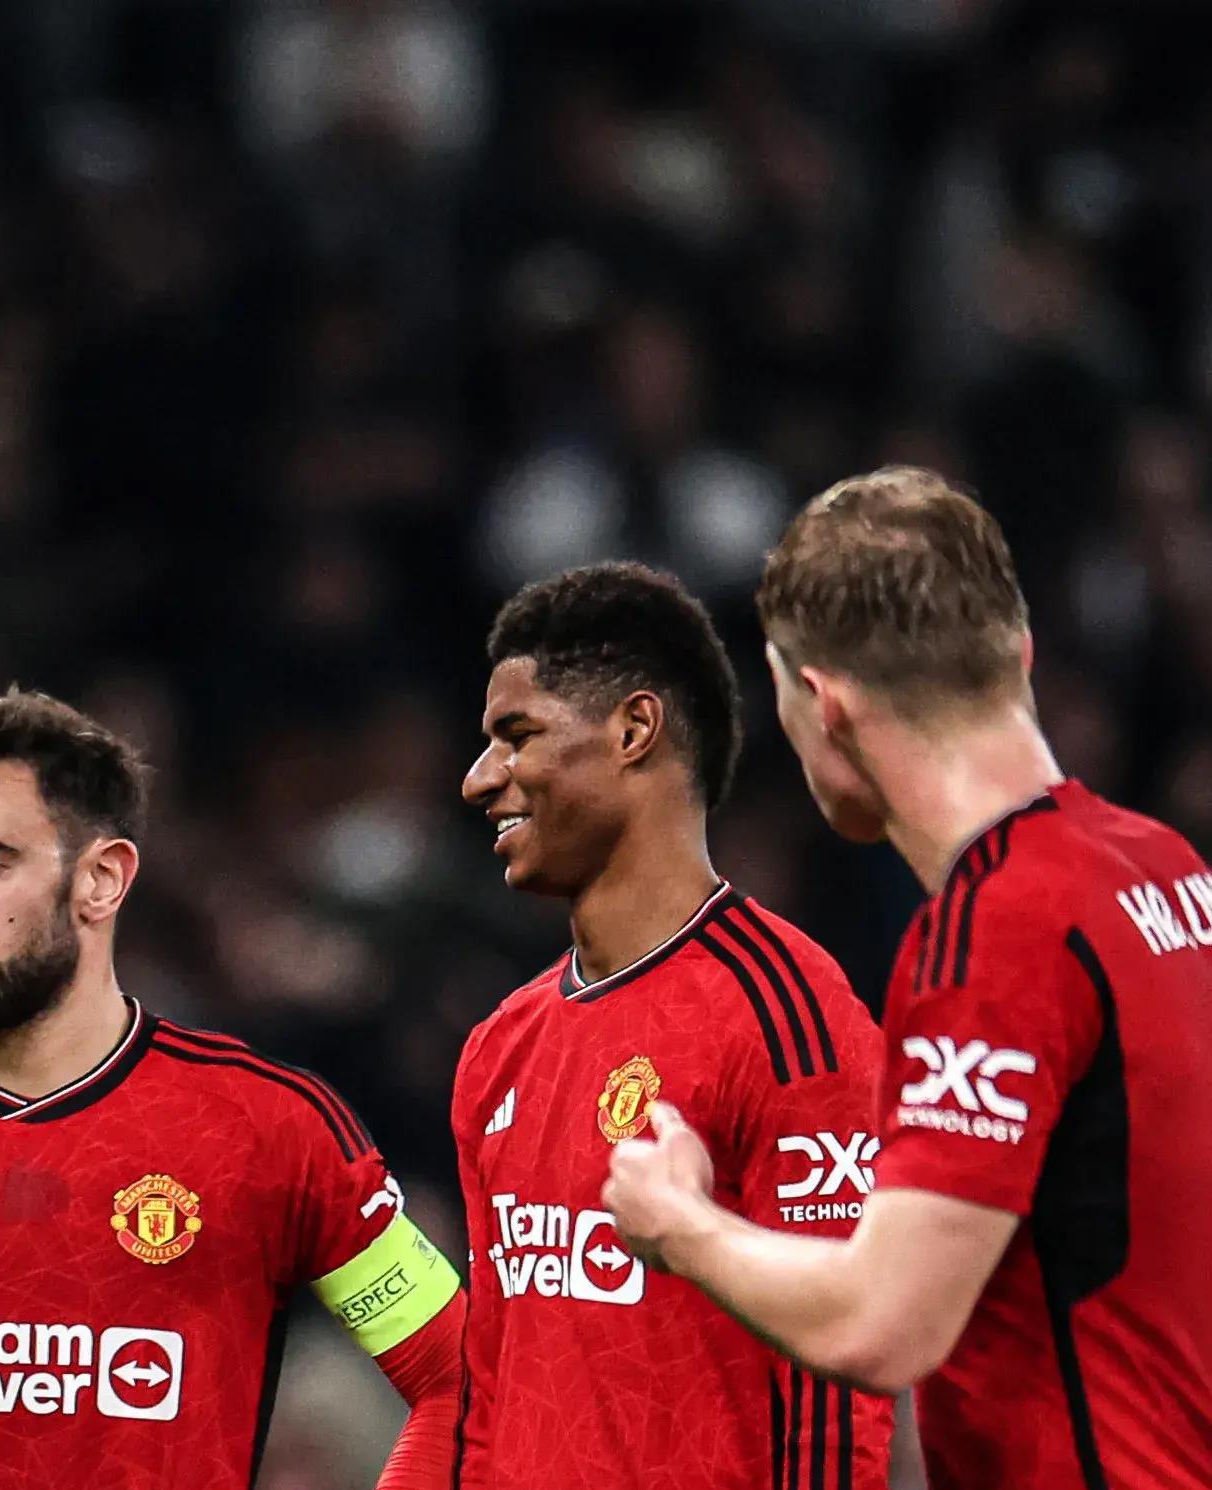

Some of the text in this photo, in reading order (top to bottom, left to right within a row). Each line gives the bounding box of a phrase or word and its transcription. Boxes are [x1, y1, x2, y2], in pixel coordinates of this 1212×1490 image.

[901, 1036, 1037, 1122] DXC
[120, 1180, 194, 1211] MANCHESTER
[131, 1241, 182, 1258] UNITED
[340, 1267, 410, 1324] ESPECT
